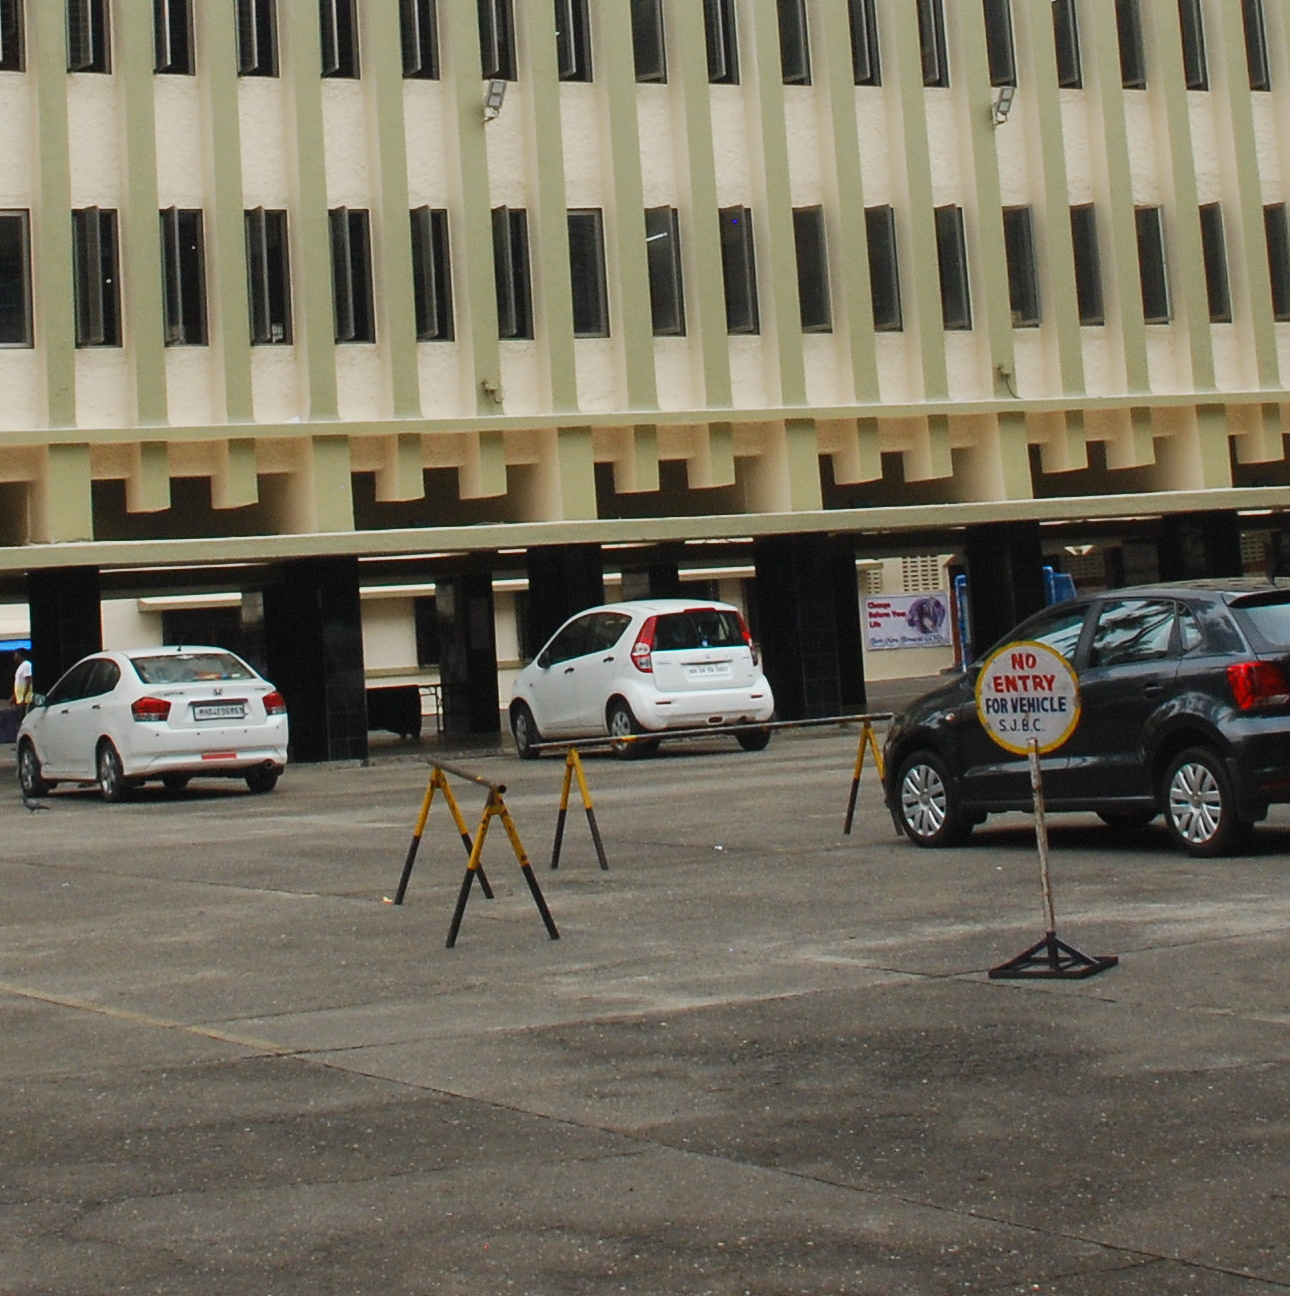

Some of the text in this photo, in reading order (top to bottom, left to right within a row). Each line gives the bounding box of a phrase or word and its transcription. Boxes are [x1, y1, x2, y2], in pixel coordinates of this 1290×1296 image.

[1011, 653, 1037, 670] NO
[992, 674, 1056, 693] ENTRY
[985, 696, 1067, 714] FOR VEHICLE
